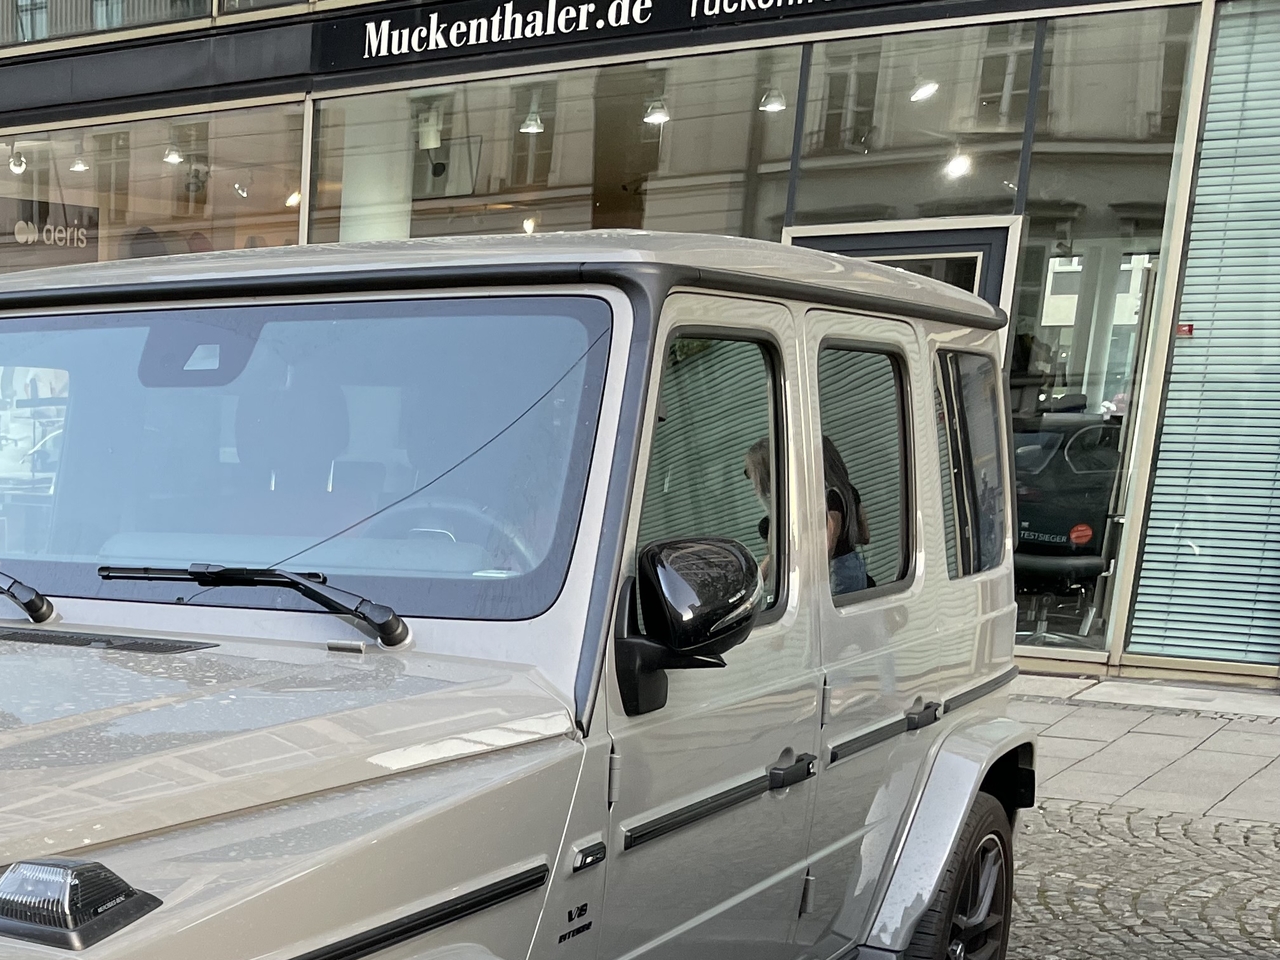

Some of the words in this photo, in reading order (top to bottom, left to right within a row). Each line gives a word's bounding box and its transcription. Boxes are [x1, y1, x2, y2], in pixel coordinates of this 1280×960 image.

[362, 0, 652, 58] Muckenthaler.de
[42, 220, 87, 248] aeris
[1020, 531, 1067, 542] TESTSIEGER
